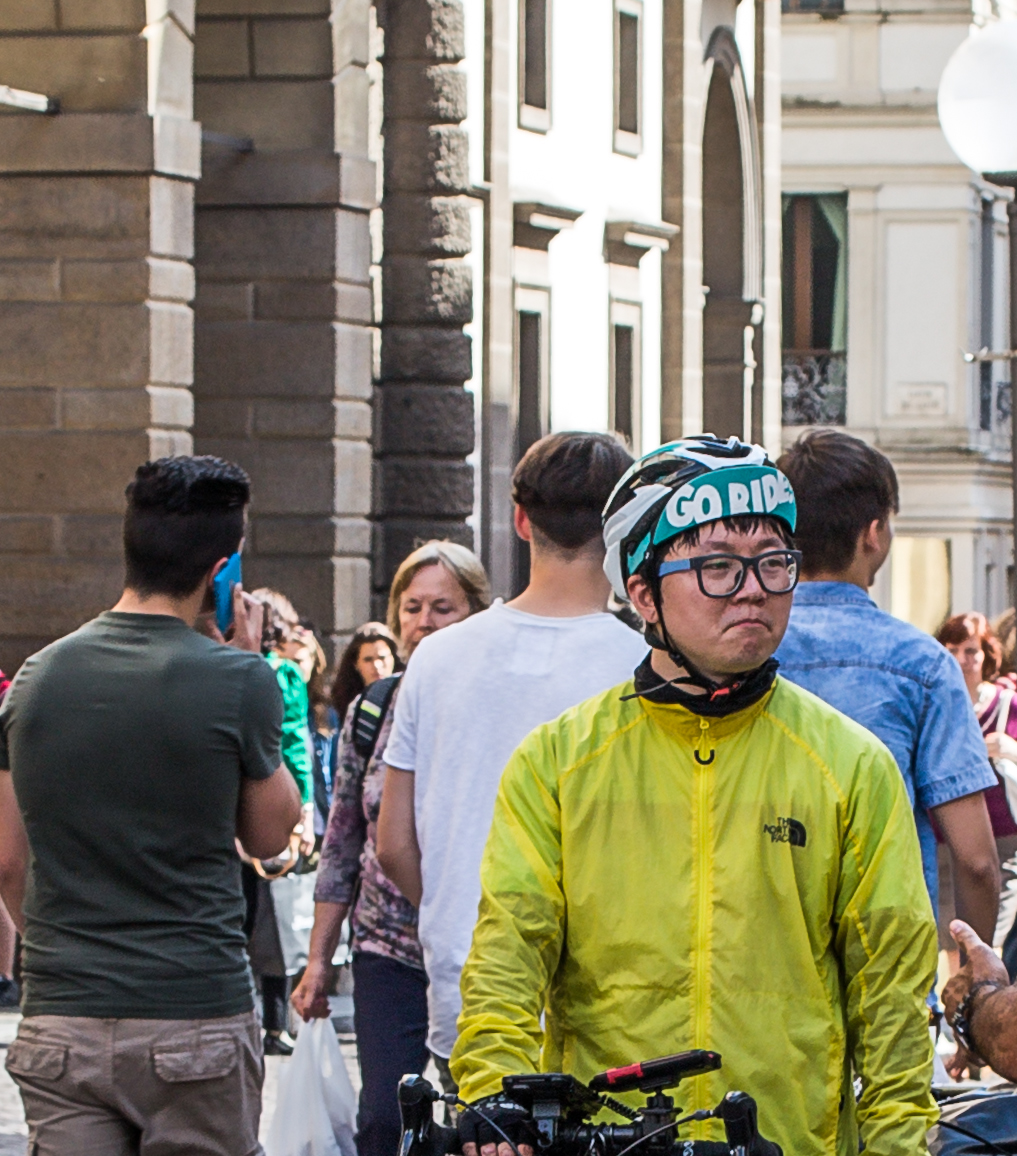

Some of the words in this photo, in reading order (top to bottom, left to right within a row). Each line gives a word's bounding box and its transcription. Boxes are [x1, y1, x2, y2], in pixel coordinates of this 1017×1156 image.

[666, 484, 722, 528] GO
[763, 823, 790, 837] NORT
[770, 832, 791, 843] FAC
